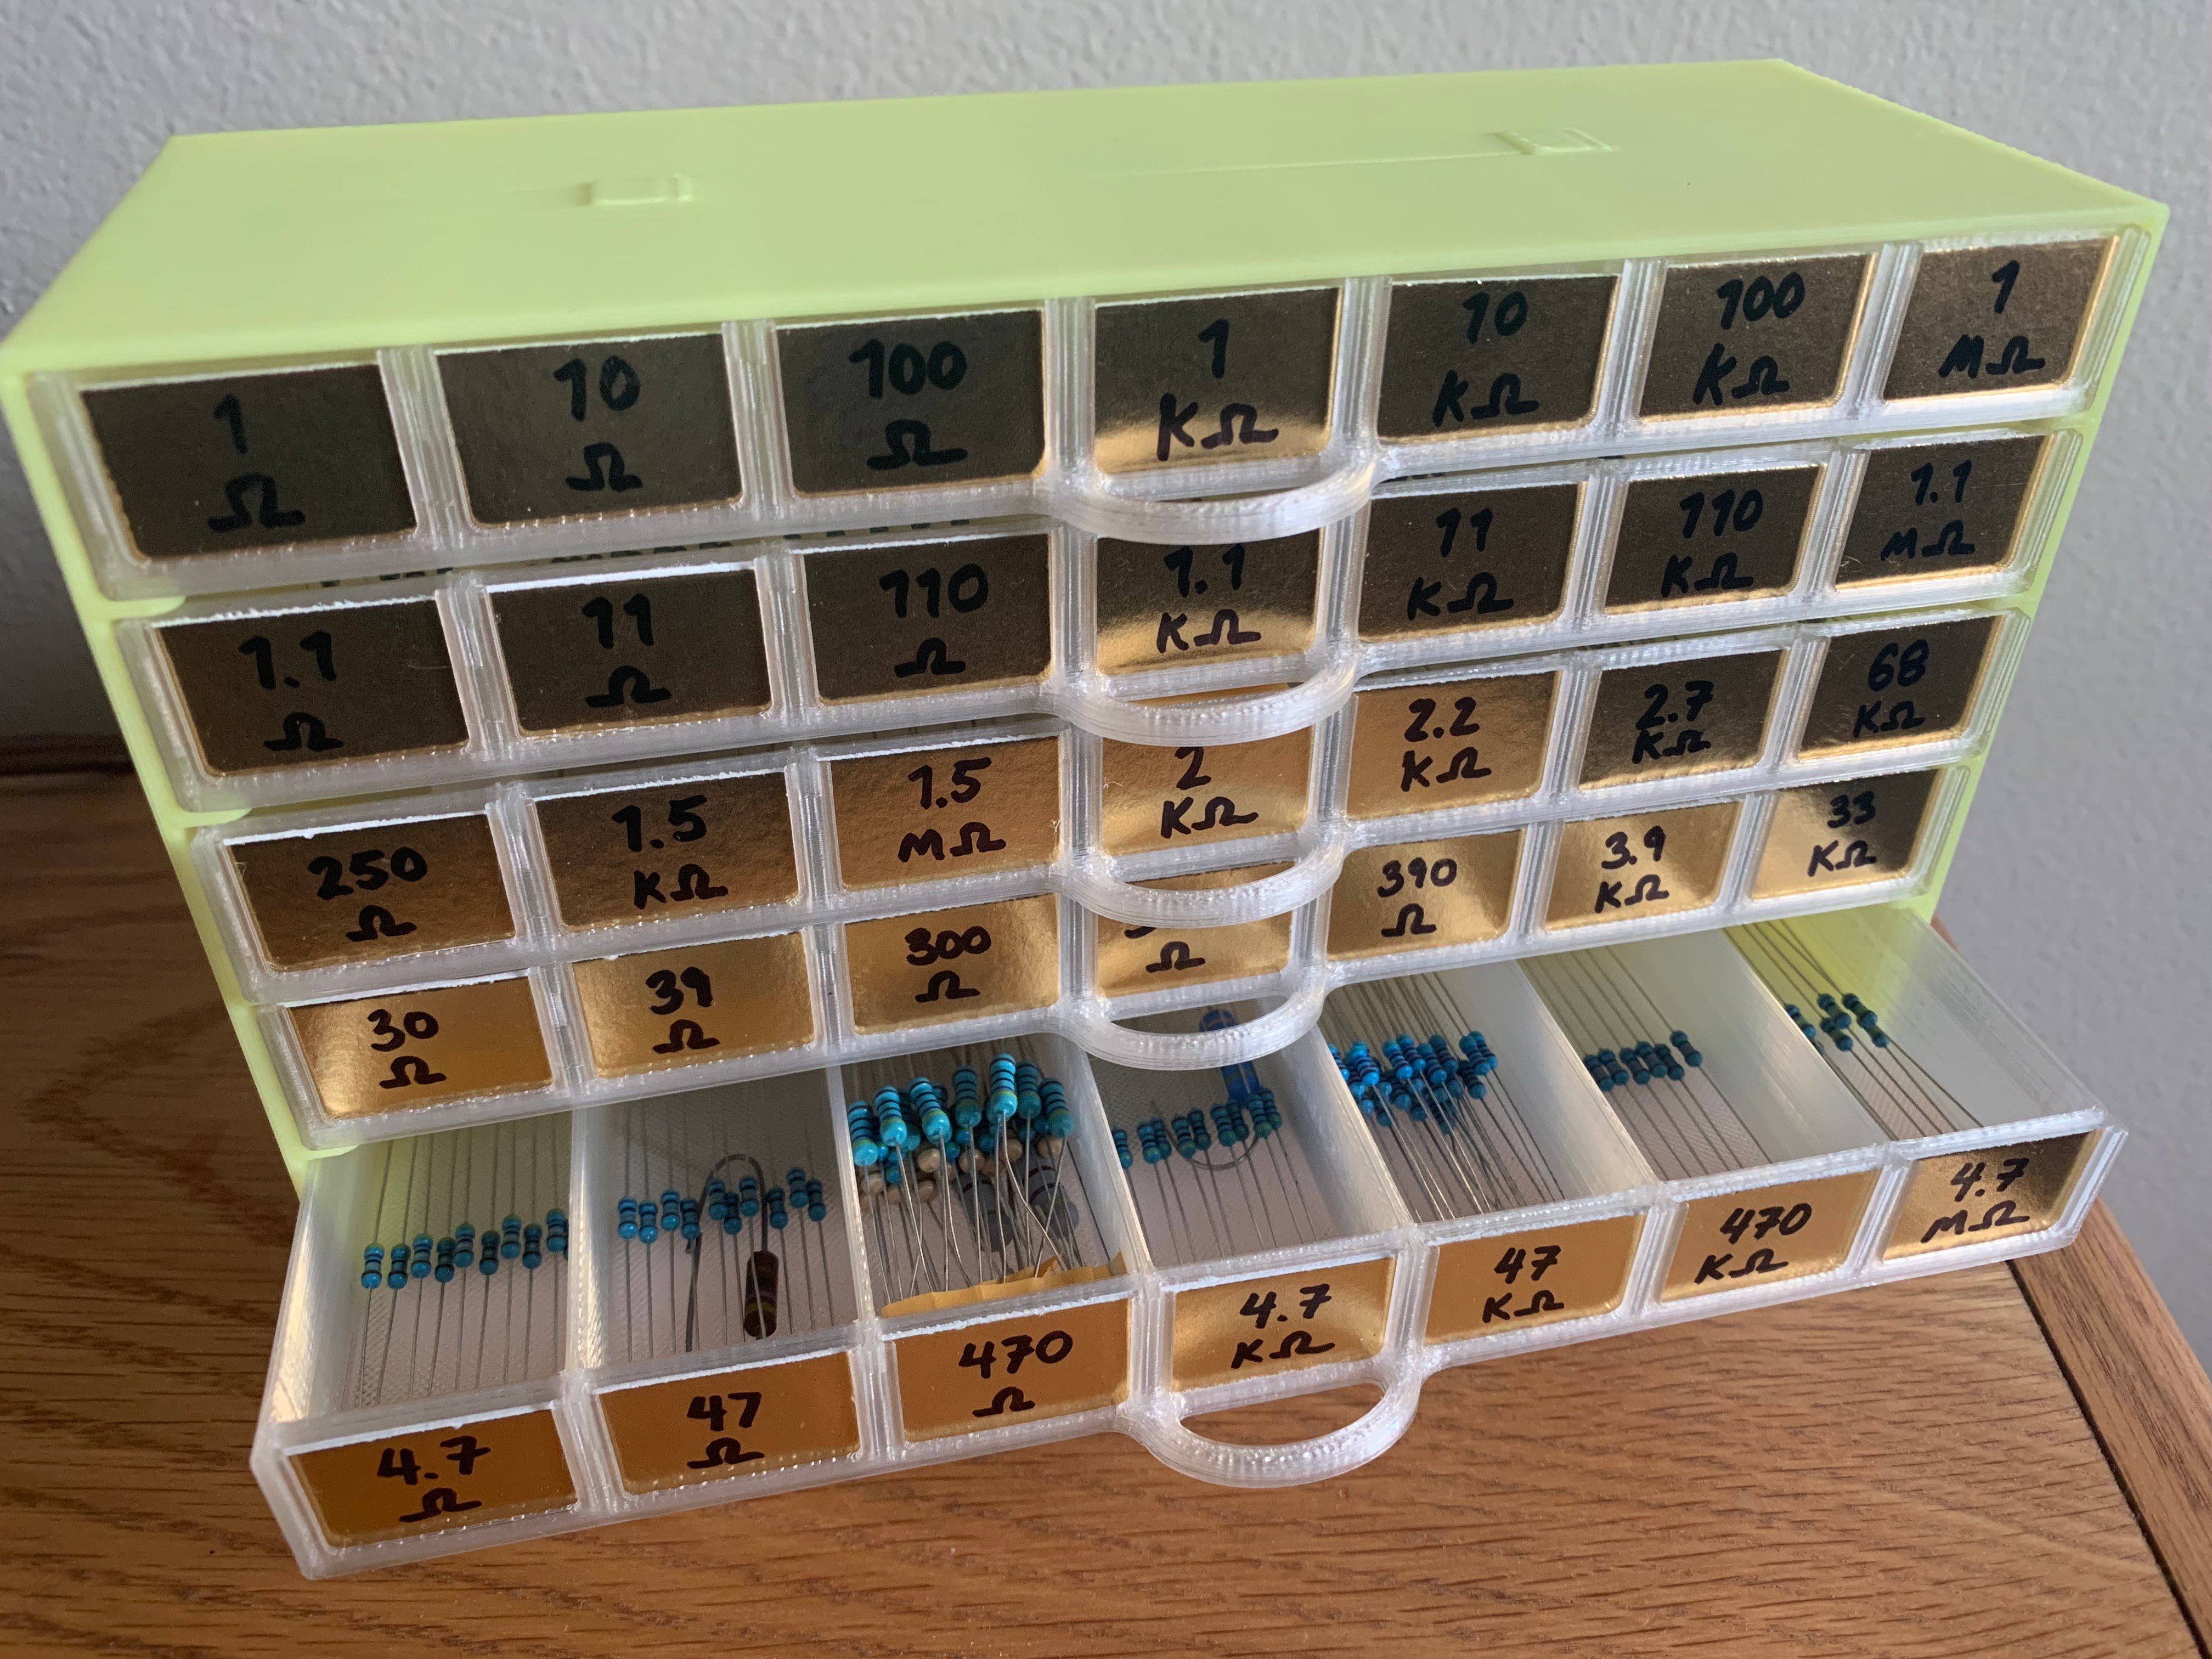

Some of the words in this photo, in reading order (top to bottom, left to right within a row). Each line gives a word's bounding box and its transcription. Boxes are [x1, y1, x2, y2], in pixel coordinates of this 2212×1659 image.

[1716, 273, 1805, 329] 100
[1992, 261, 2020, 314] 1
[1462, 291, 1527, 344] 10
[849, 340, 967, 398] 100
[1198, 319, 1229, 379] 1
[554, 357, 641, 422] 10
[212, 394, 247, 454] 1
[868, 420, 967, 470] Ω
[566, 443, 644, 492] Ω
[1911, 461, 1972, 505] 1.1
[208, 473, 305, 532] Ω
[1680, 489, 1763, 539] 110
[1436, 508, 1492, 557] 11
[880, 564, 989, 618] 110
[1163, 543, 1245, 599] 1.1
[582, 594, 653, 650] 11
[240, 630, 336, 689] 1.1
[894, 637, 966, 678] Ω
[1868, 640, 1927, 691] 68
[585, 665, 672, 707] Ω
[1637, 681, 1714, 727] 2.7
[263, 712, 344, 752] Ω
[1404, 697, 1479, 742] 2.2
[907, 758, 992, 809] 1.5
[1176, 747, 1211, 790] 2
[612, 795, 708, 852] 1.5
[1827, 791, 1876, 827] 33
[1601, 826, 1667, 869] 3.9
[307, 847, 427, 900] 250
[1376, 857, 1457, 898] 390
[346, 905, 417, 941] Ω
[1381, 904, 1436, 936] Ω
[905, 927, 991, 964] 300
[1146, 941, 1206, 973] Ω
[646, 967, 713, 1015] 39
[914, 969, 979, 1002] Ω
[368, 1009, 439, 1051] 30
[652, 1019, 720, 1053] Ω
[379, 1055, 447, 1088] Ω
[1950, 1156, 2029, 1201] 4.7
[1720, 1203, 1811, 1244] 470
[1495, 1245, 1561, 1284] 47
[1240, 1284, 1332, 1328] 4.7
[959, 1331, 1073, 1379] 470
[687, 1392, 761, 1430] 47
[973, 1387, 1035, 1416] Ω
[377, 1436, 490, 1485] 4.7
[687, 1437, 764, 1469] Ω
[399, 1488, 482, 1522] Ω
